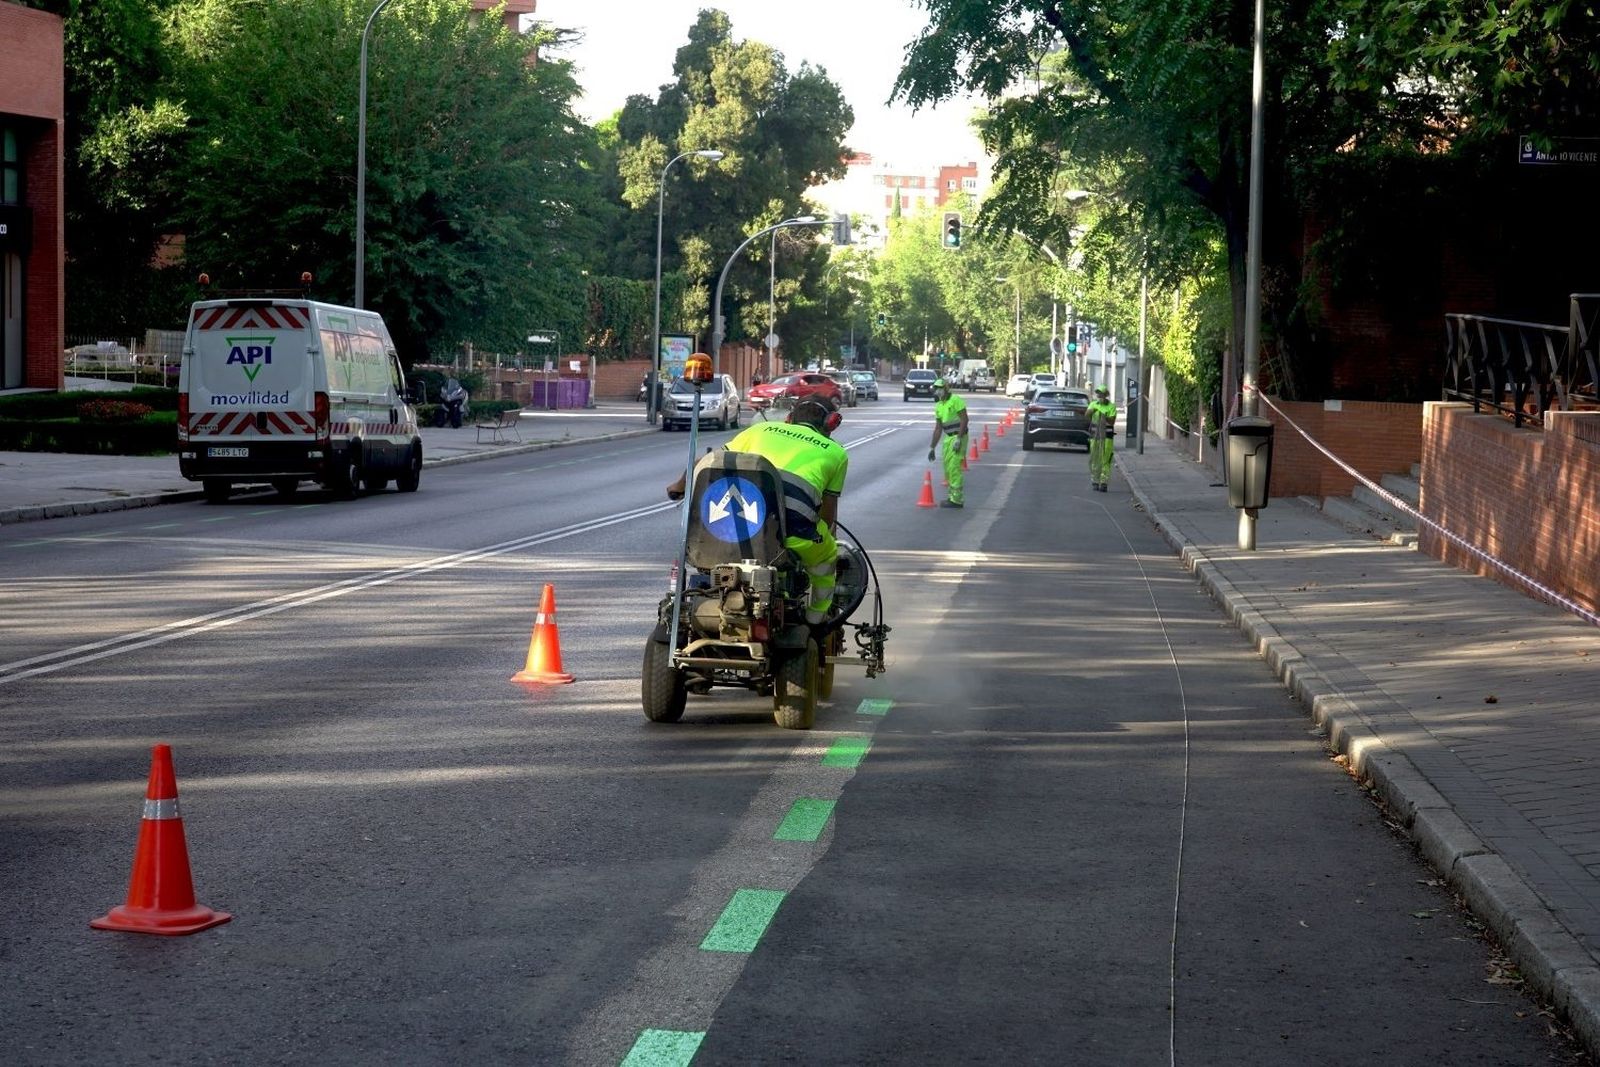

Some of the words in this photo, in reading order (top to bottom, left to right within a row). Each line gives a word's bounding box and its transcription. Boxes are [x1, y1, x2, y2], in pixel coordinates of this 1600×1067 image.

[1535, 151, 1568, 161] ANTOIO
[1568, 152, 1598, 162] VICENTE
[226, 346, 272, 365] API
[211, 390, 289, 406] movilidad
[764, 426, 830, 449] Movilidad
